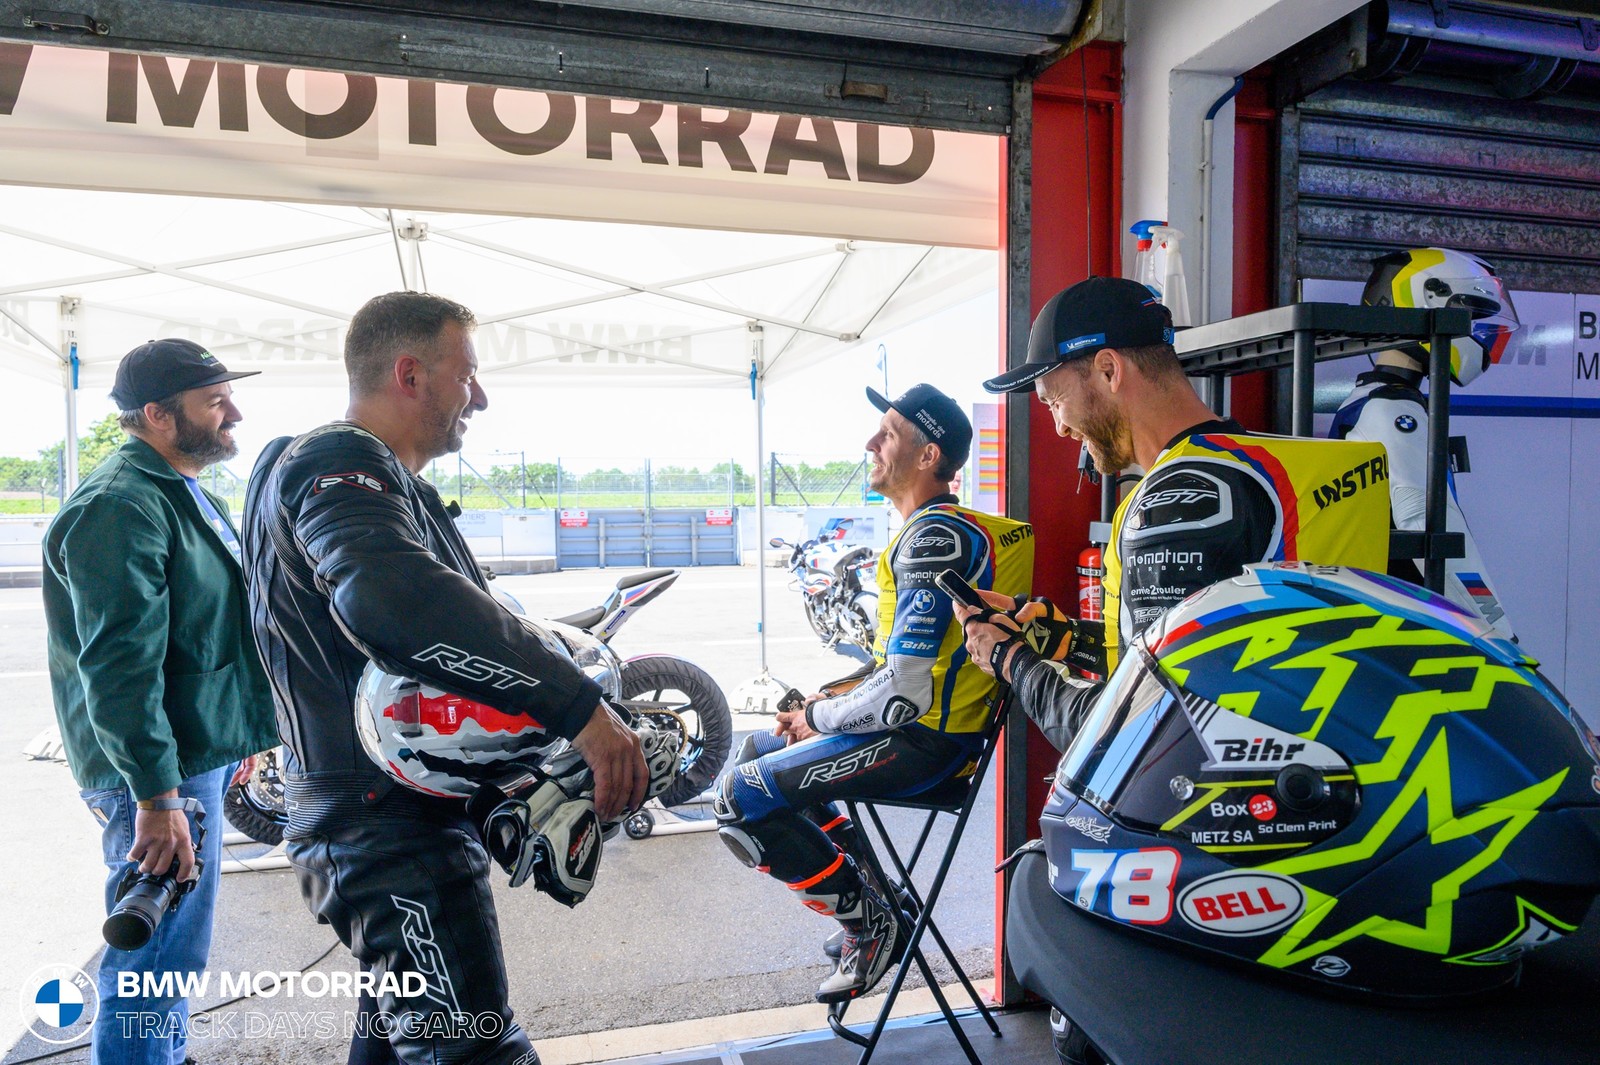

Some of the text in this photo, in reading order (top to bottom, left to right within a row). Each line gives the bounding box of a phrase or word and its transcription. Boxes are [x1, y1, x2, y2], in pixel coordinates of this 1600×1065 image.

[106, 51, 935, 185] MOTORRAD
[1016, 373, 1035, 384] TRACK
[1034, 365, 1049, 376] DAYS
[915, 411, 942, 439] motards
[899, 640, 935, 650] Bihr
[411, 643, 541, 689] RST
[798, 737, 892, 790] RST
[1214, 738, 1305, 762] Bihr
[1210, 800, 1274, 817] Box 23
[1191, 830, 1254, 844] METZ SA
[1276, 823, 1305, 833] Clem
[1308, 820, 1337, 831] Print
[1071, 846, 1182, 926] 78
[1192, 887, 1287, 922] BELL
[390, 895, 464, 1023] RST
